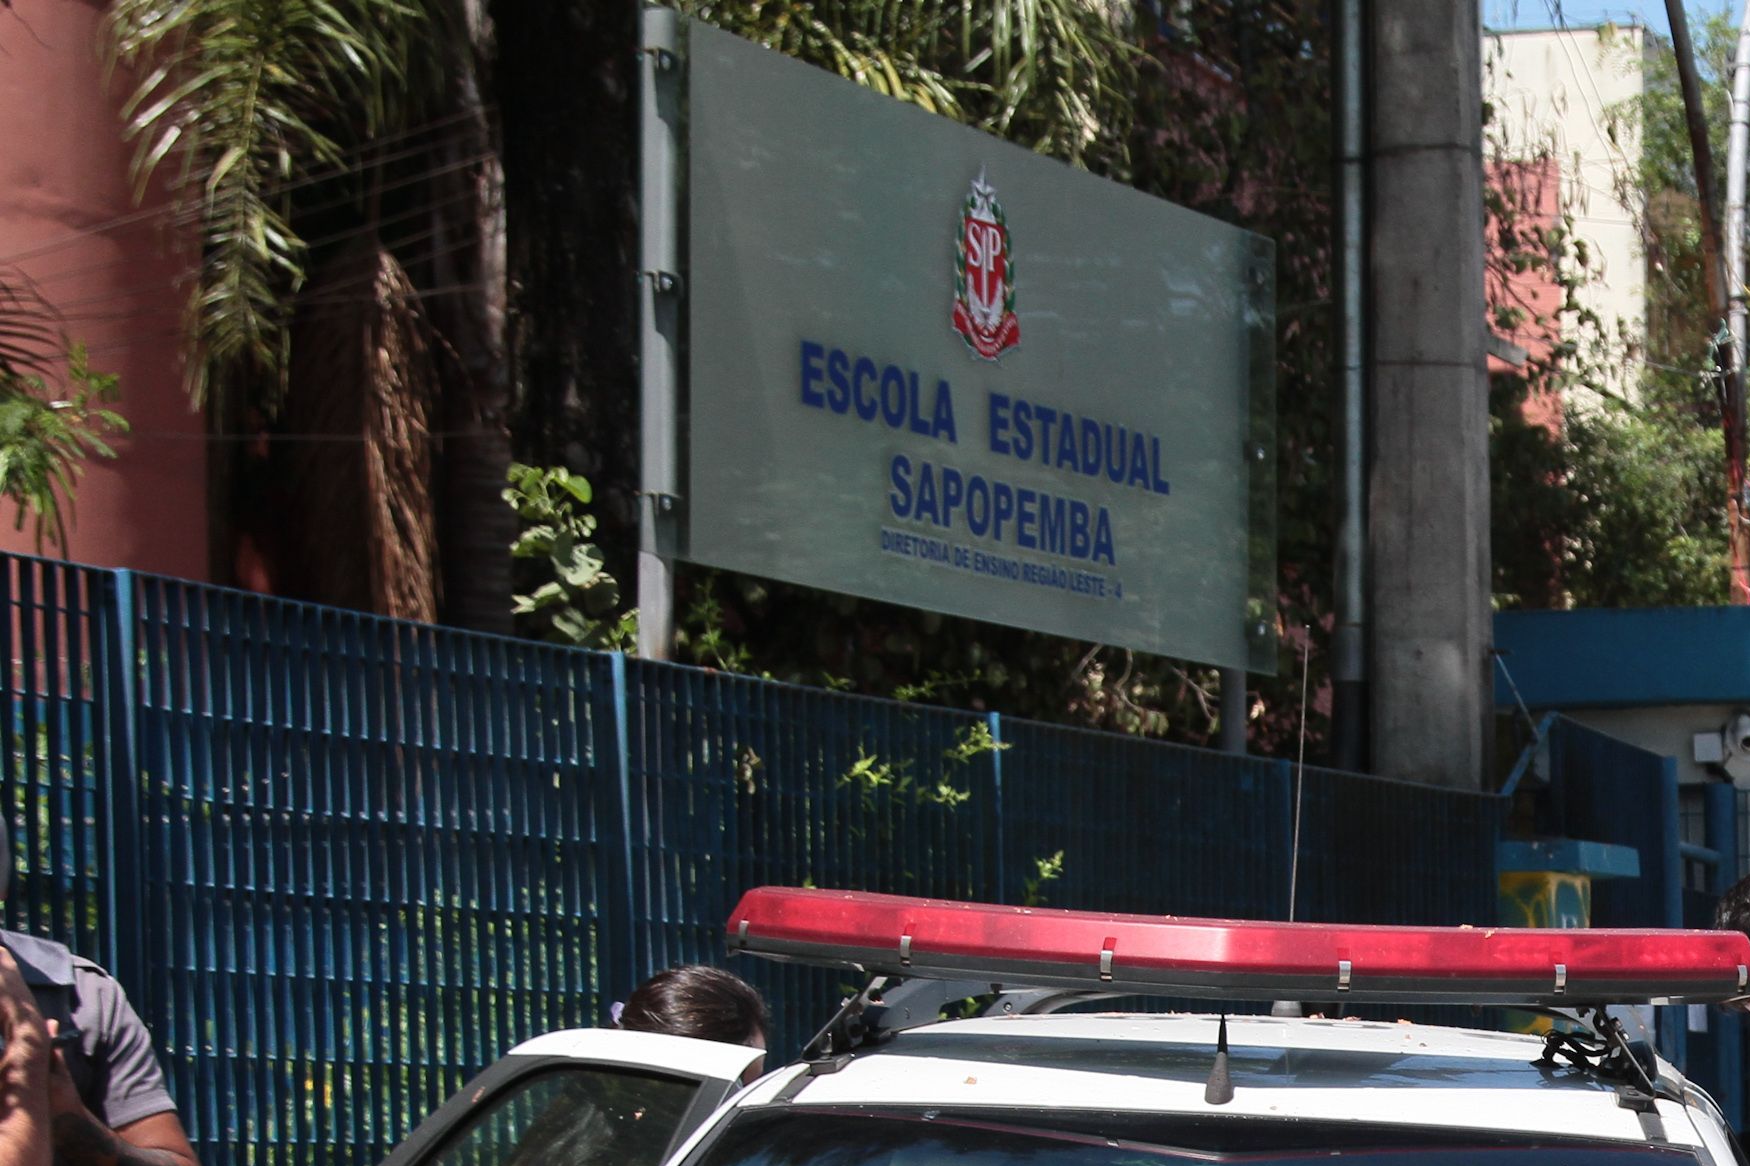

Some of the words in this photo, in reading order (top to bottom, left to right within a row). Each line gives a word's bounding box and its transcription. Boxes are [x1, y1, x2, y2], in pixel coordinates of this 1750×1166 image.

[800, 339, 958, 444] ESCOLA
[988, 392, 1170, 495] ESTADUAL
[880, 530, 950, 564] DIRETORIA
[954, 546, 971, 569] DE
[973, 551, 1019, 580] ENSINO
[1022, 563, 1067, 589] REGIÃO
[1069, 570, 1105, 597] LESTE
[889, 454, 1116, 567] SAPOPEMBA
